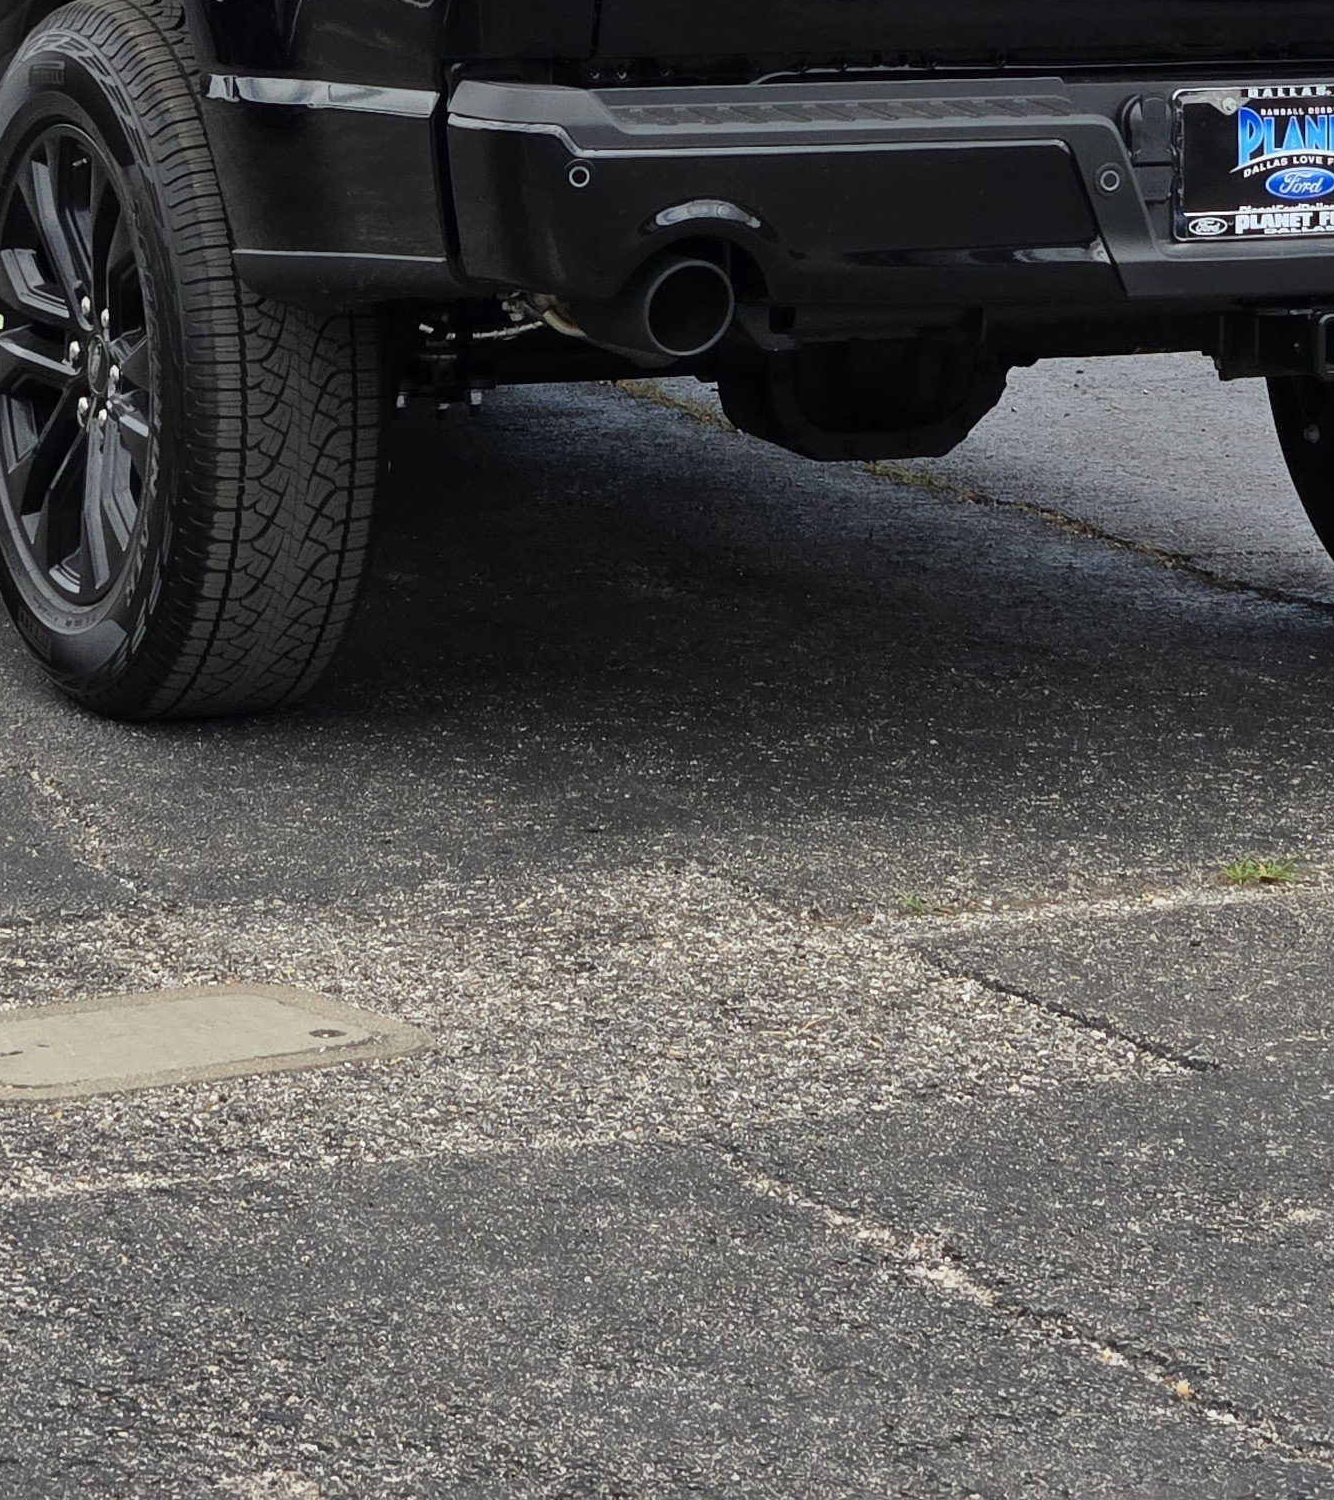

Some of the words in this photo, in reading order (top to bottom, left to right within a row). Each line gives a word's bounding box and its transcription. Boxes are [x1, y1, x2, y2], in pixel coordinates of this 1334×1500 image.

[1243, 156, 1289, 178] DALLAS
[1293, 155, 1324, 165] LOVE
[1278, 171, 1324, 194] Ford
[1235, 212, 1314, 235] PLANET
